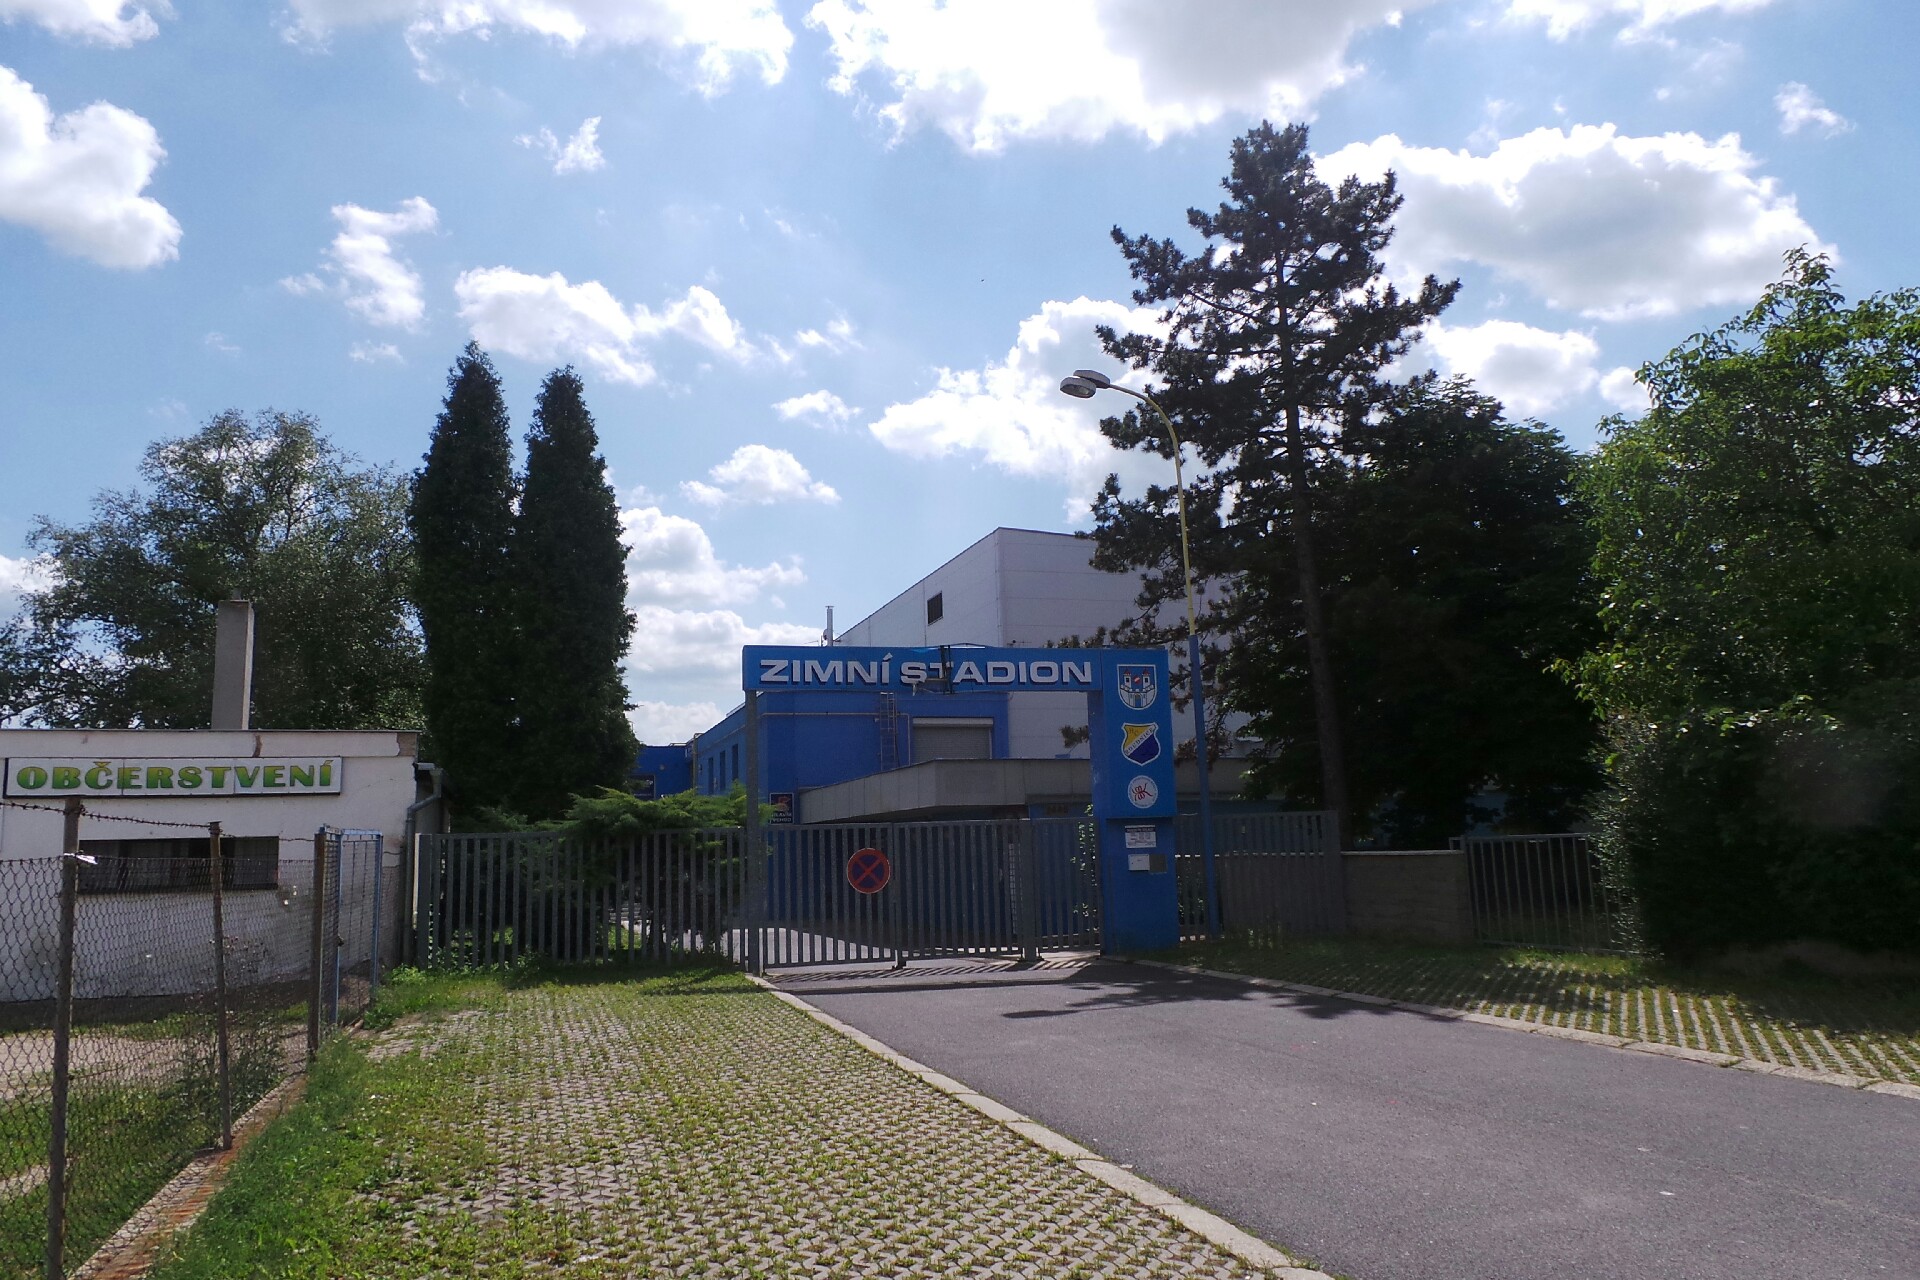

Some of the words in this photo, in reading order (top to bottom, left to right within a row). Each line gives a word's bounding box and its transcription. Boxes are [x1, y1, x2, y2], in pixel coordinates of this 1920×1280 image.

[760, 652, 893, 684] ZIMNÍ
[901, 661, 1092, 684] STADION
[1124, 727, 1153, 756] ROUDNICE
[16, 759, 334, 790] OBČERSTVENÍ
